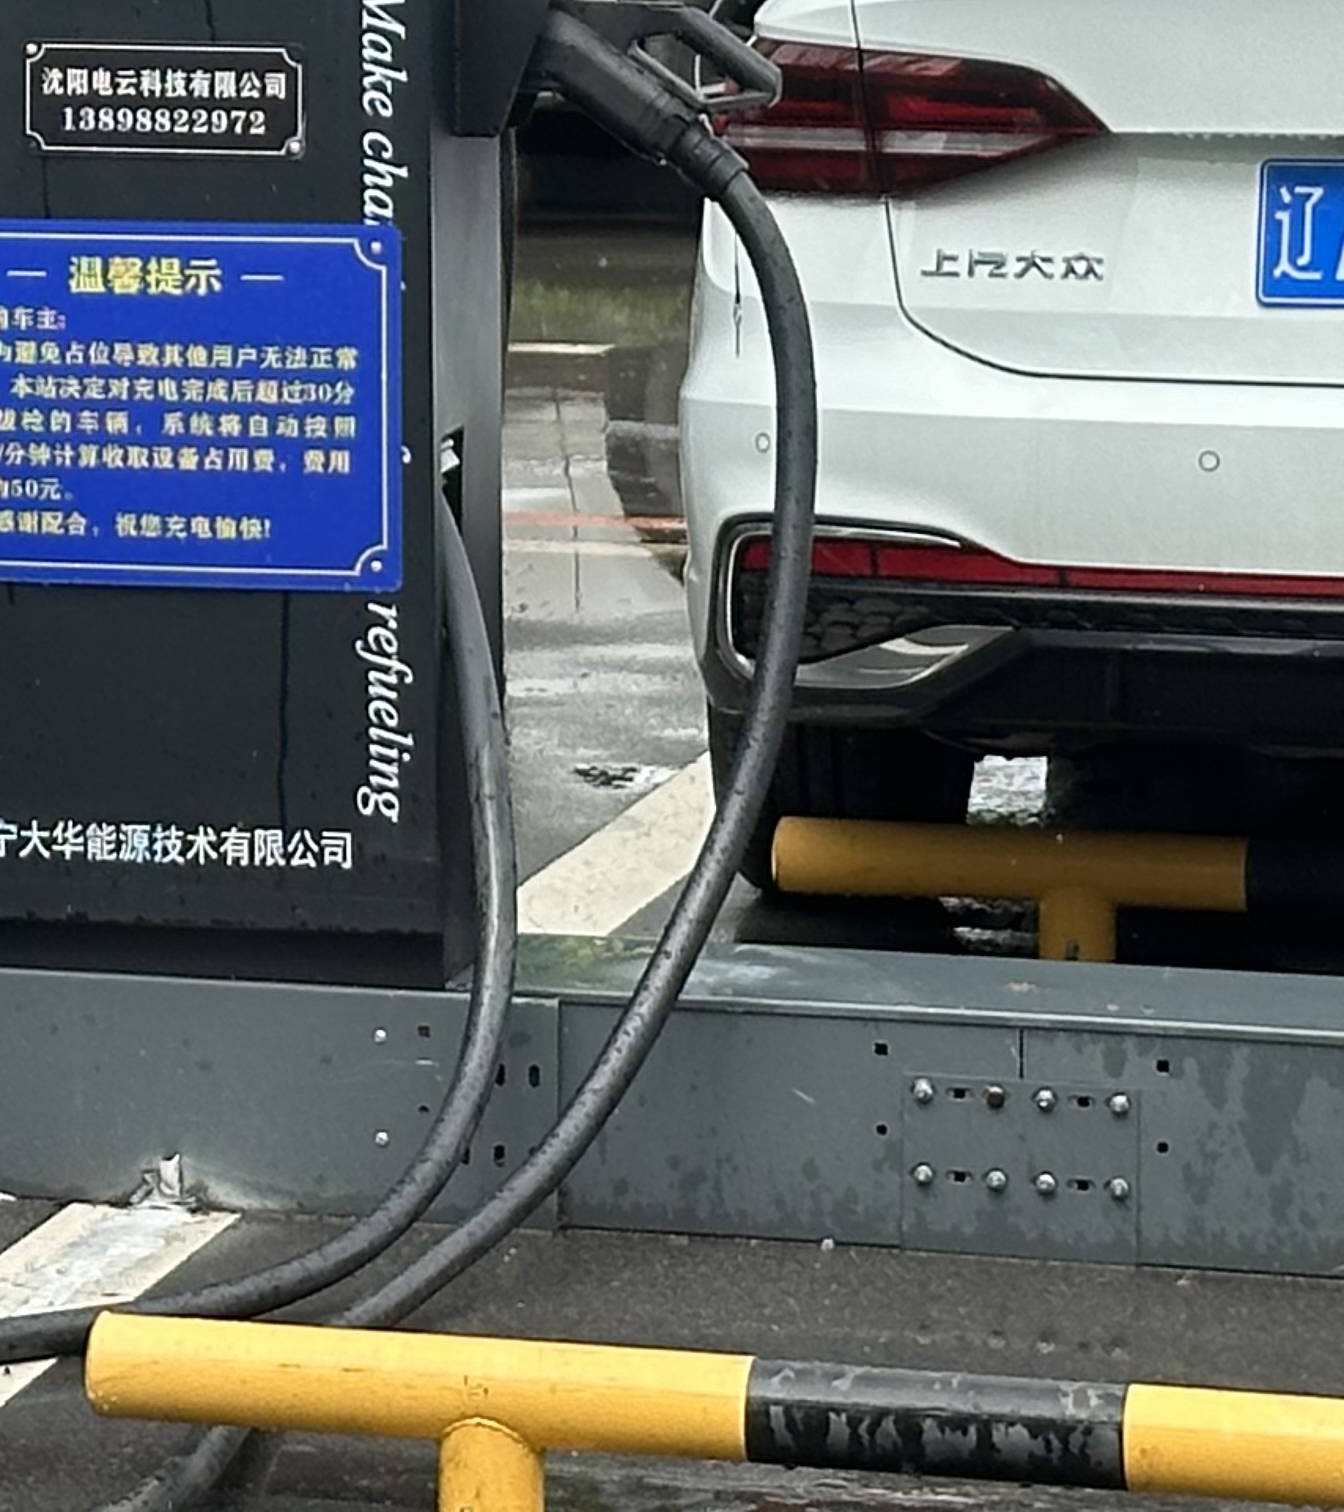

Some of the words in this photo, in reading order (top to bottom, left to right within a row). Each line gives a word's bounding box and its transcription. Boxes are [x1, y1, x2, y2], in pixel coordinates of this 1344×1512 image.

[41, 67, 287, 100] 沈阳电云科技有限公司
[62, 106, 267, 135] 13898822972
[362, 131, 409, 226] cha
[1273, 186, 1344, 281] 辽
[68, 256, 223, 296] 温馨提示
[921, 249, 1104, 281] 上汽大众
[355, 602, 414, 824] refueling
